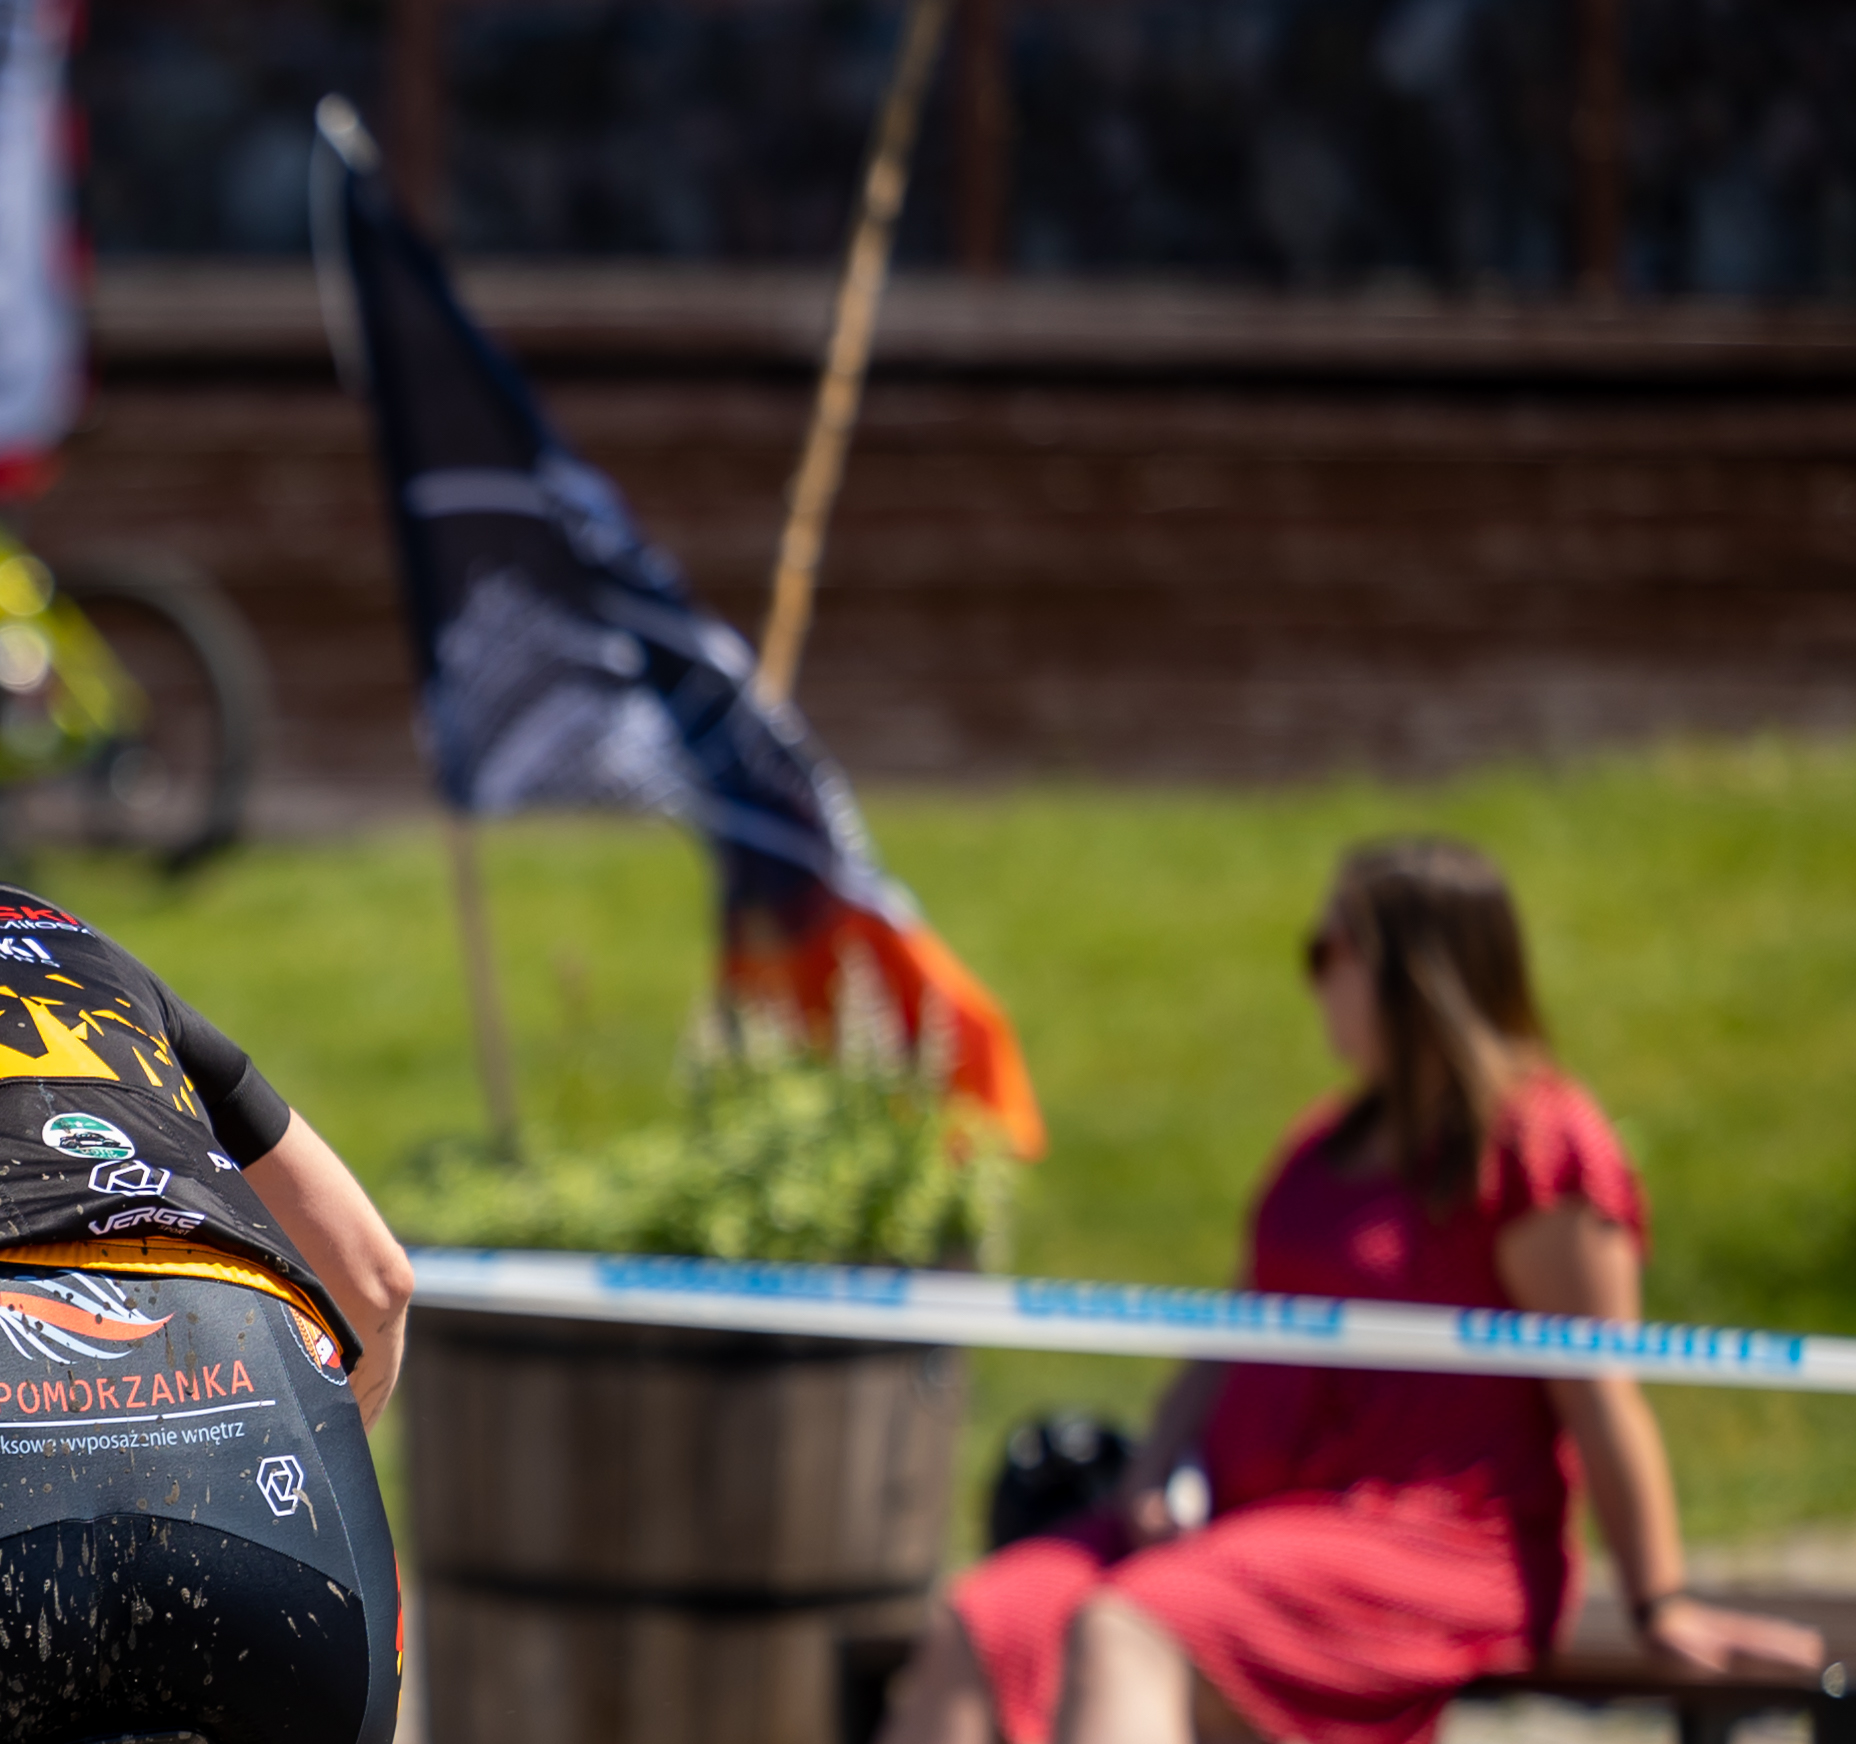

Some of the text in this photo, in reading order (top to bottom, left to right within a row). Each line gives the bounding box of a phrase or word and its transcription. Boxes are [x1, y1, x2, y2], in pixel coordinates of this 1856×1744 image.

[87, 1206, 206, 1236] VERGE
[158, 1224, 191, 1236] SPORT
[181, 1421, 246, 1446] wnętrz
